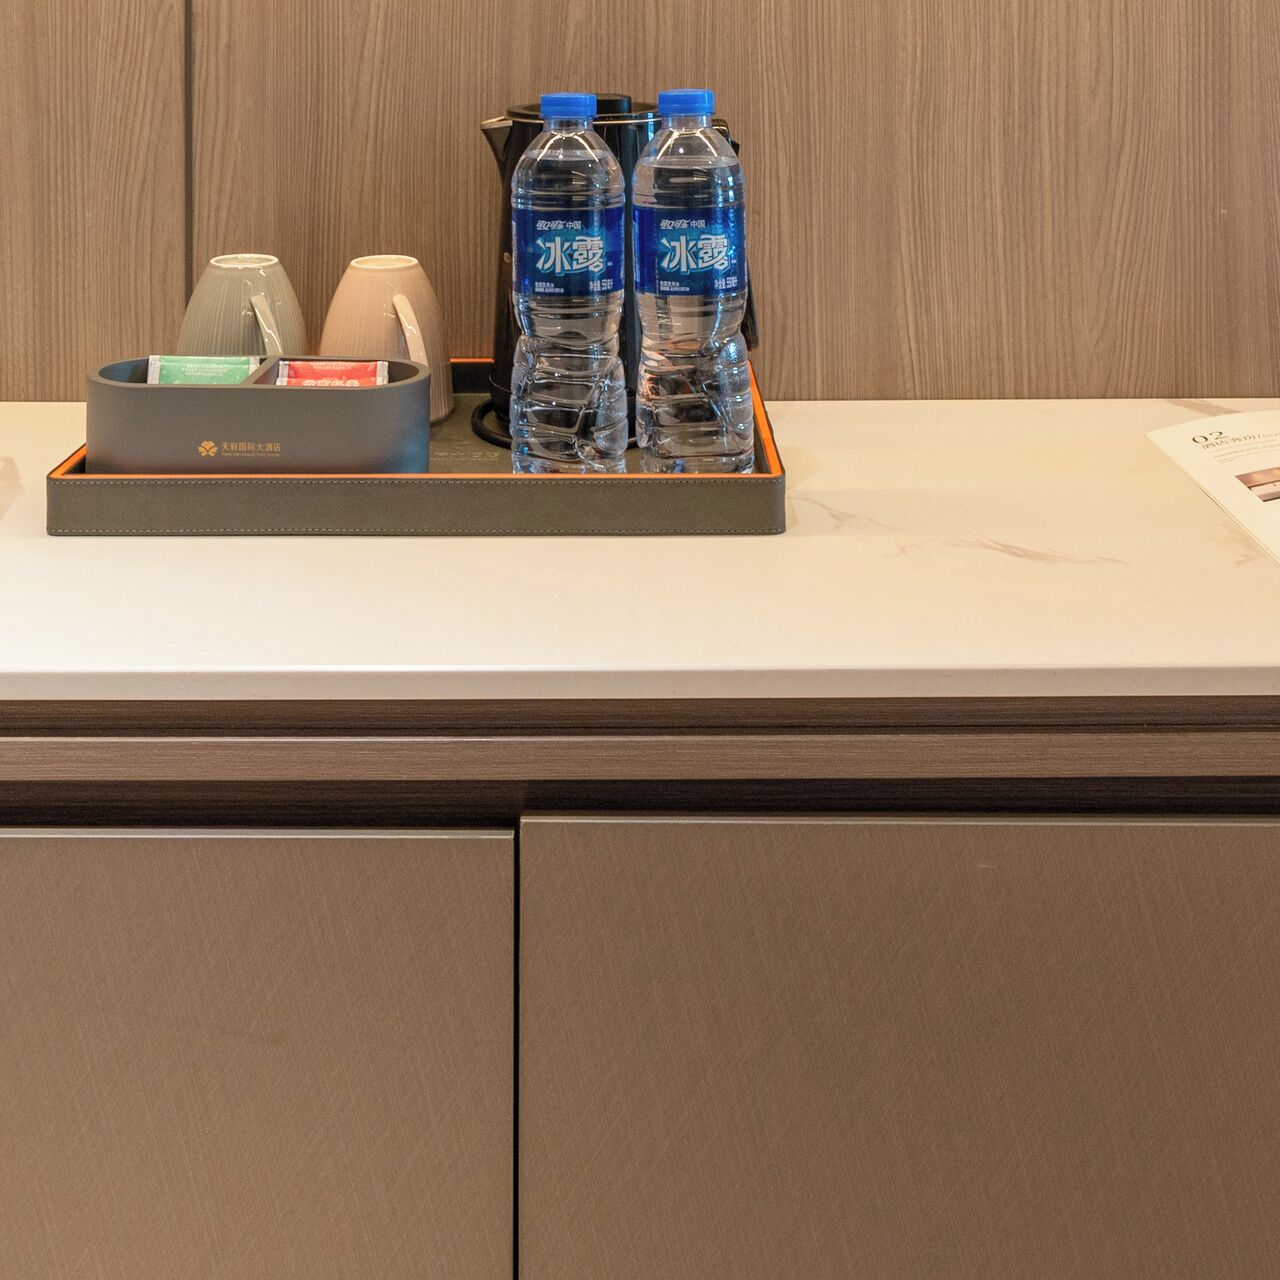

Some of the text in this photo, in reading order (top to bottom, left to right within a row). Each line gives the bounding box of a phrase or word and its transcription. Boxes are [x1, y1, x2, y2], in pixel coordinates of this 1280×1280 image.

[535, 235, 604, 274] 冰露
[661, 234, 728, 272] 冰露
[1192, 430, 1229, 445] 02
